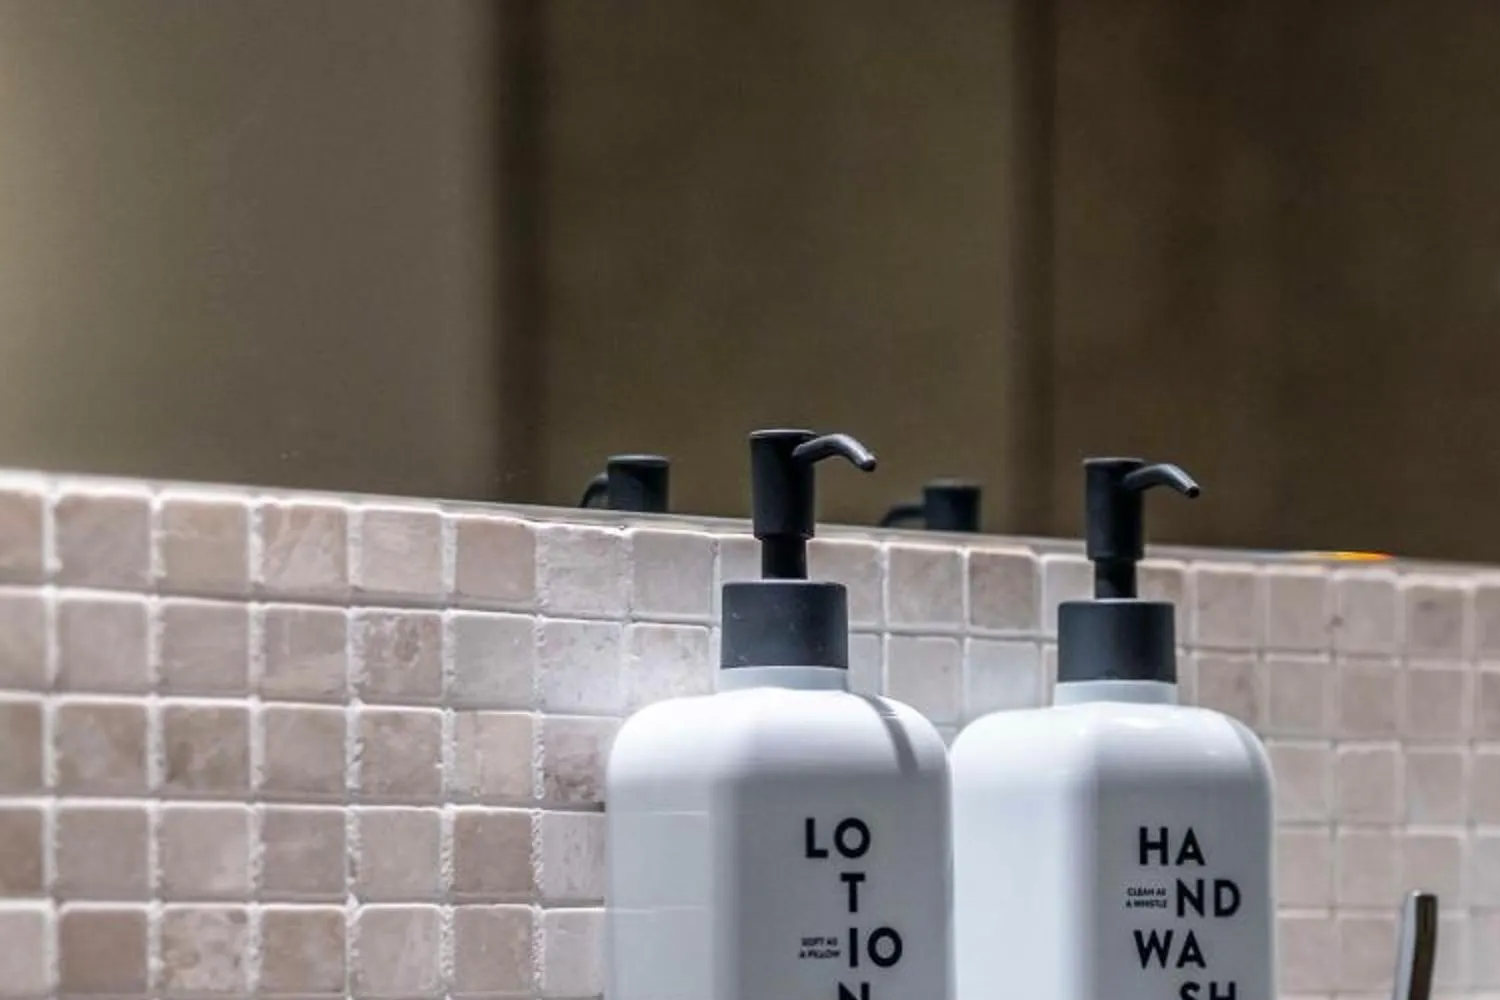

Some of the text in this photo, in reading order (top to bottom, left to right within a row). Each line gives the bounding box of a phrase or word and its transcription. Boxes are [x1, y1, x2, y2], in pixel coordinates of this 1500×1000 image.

[805, 817, 871, 859] LO
[1139, 826, 1206, 866] HA
[840, 872, 866, 913] T
[1176, 878, 1241, 918] ND
[849, 926, 903, 968] IO
[1133, 929, 1207, 970] WA
